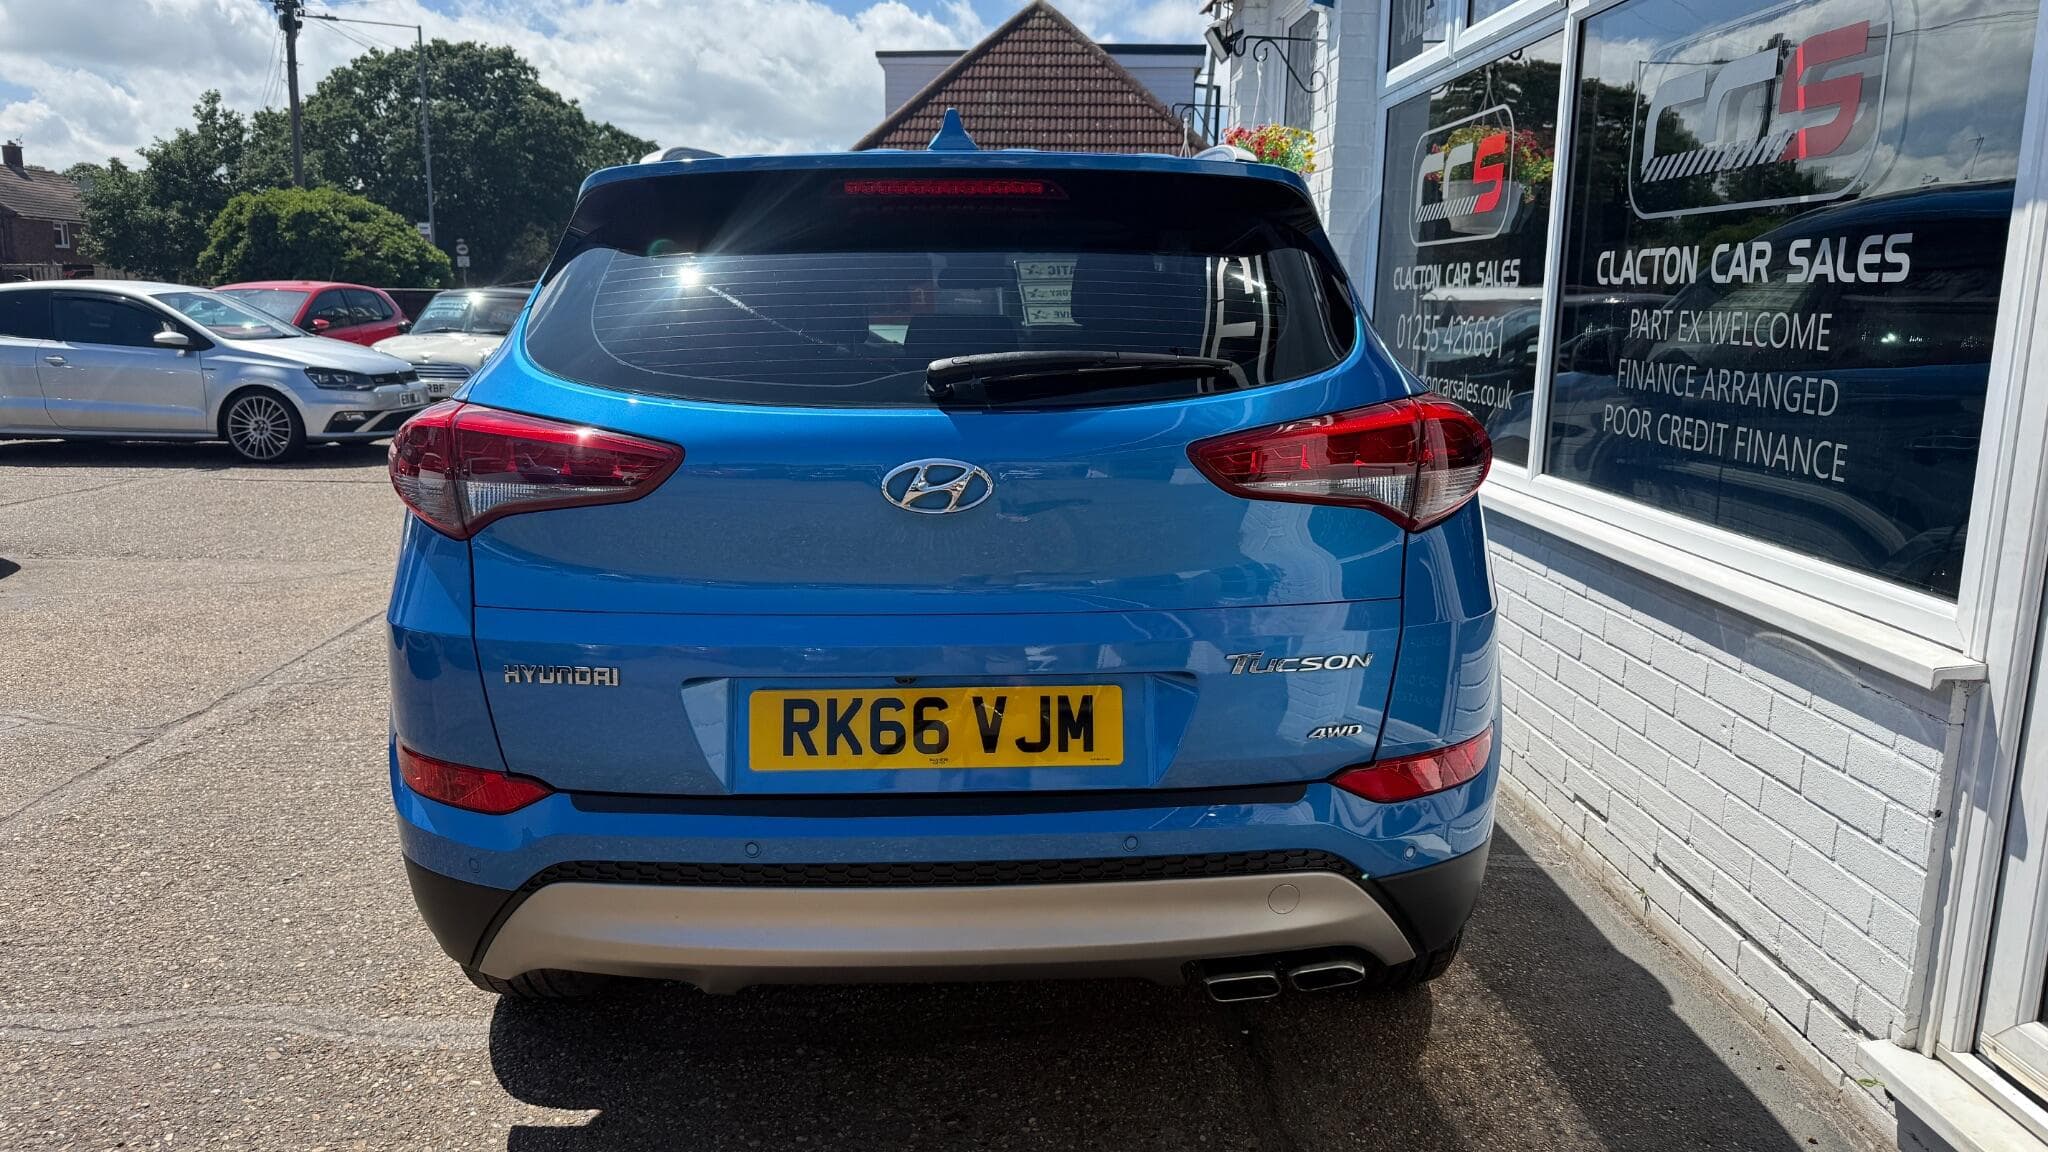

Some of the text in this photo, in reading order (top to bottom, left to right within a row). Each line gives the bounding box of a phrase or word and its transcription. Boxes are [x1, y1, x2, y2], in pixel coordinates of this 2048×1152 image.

[1640, 20, 1870, 183] CCS
[1415, 131, 1507, 223] CCS
[1393, 258, 1521, 291] CLACTON CAR SALES
[1597, 232, 1914, 286] CLACTON CAR SALES
[1396, 313, 1506, 359] 01255 426661
[1629, 308, 1833, 352] PART EX WELCOME
[1617, 358, 1839, 417] FINANCE ARRANGED
[1603, 403, 1848, 482] POOR CREDIT FINANCE
[503, 664, 619, 687] HYUNDAI
[1225, 650, 1374, 675] TUCSON
[782, 694, 1095, 757] RK66 VJM
[1307, 723, 1364, 741] 4WD
